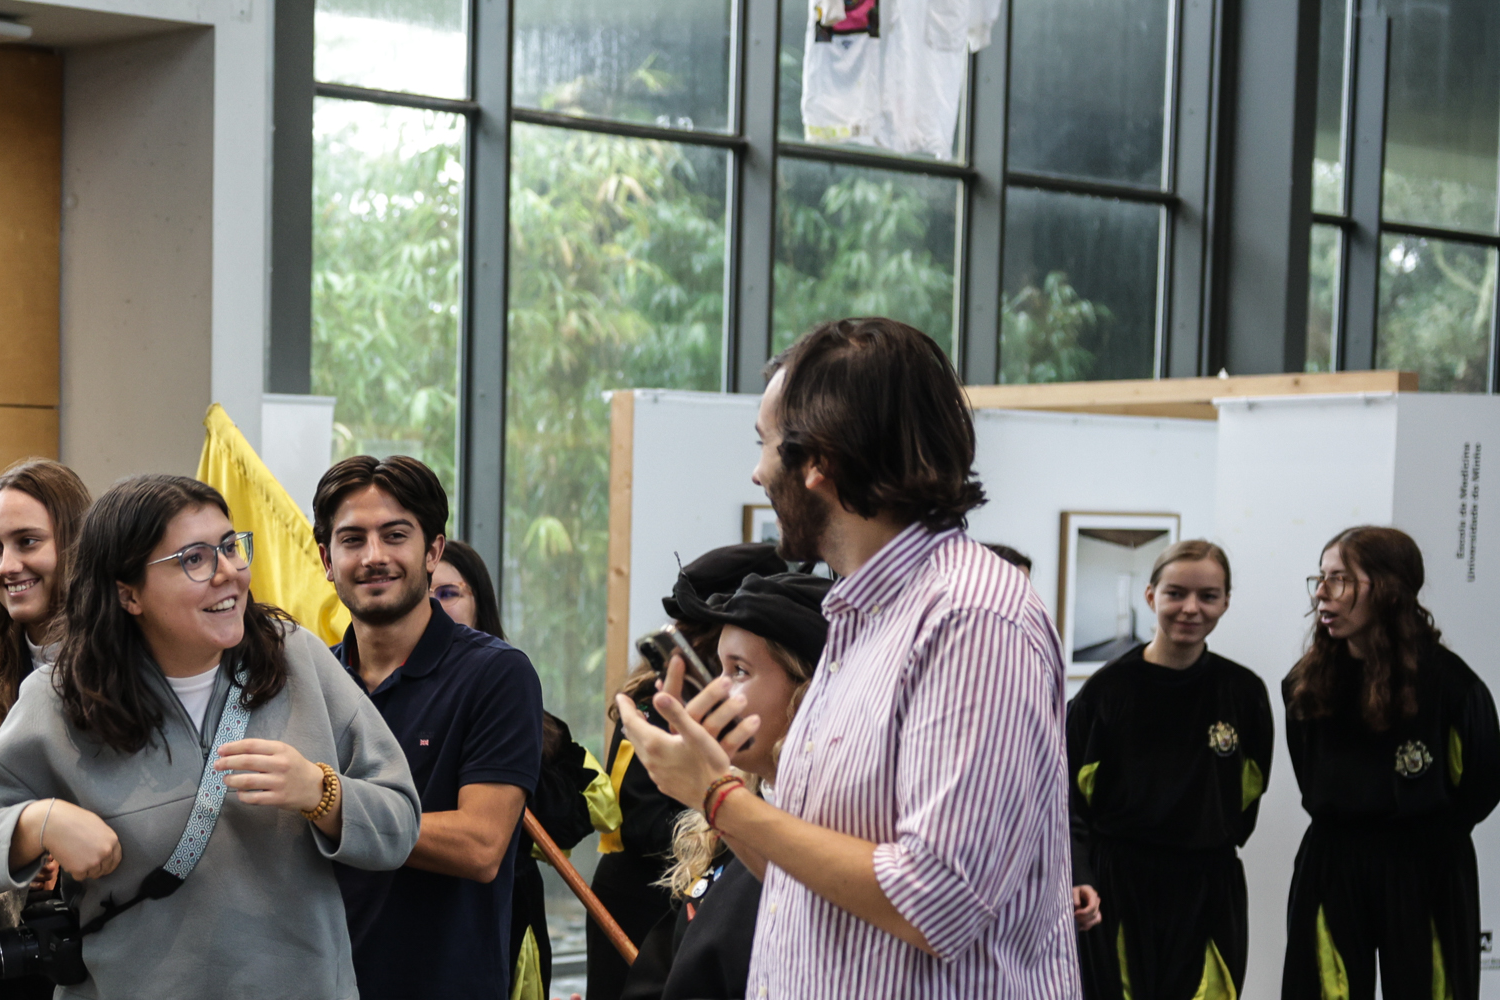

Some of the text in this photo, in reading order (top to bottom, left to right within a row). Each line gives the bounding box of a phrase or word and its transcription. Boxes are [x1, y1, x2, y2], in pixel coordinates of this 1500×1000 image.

[1460, 441, 1471, 500] Medicina
[1472, 441, 1482, 482] Minho
[1457, 520, 1466, 559] Escola
[1466, 503, 1479, 583] Universidade
